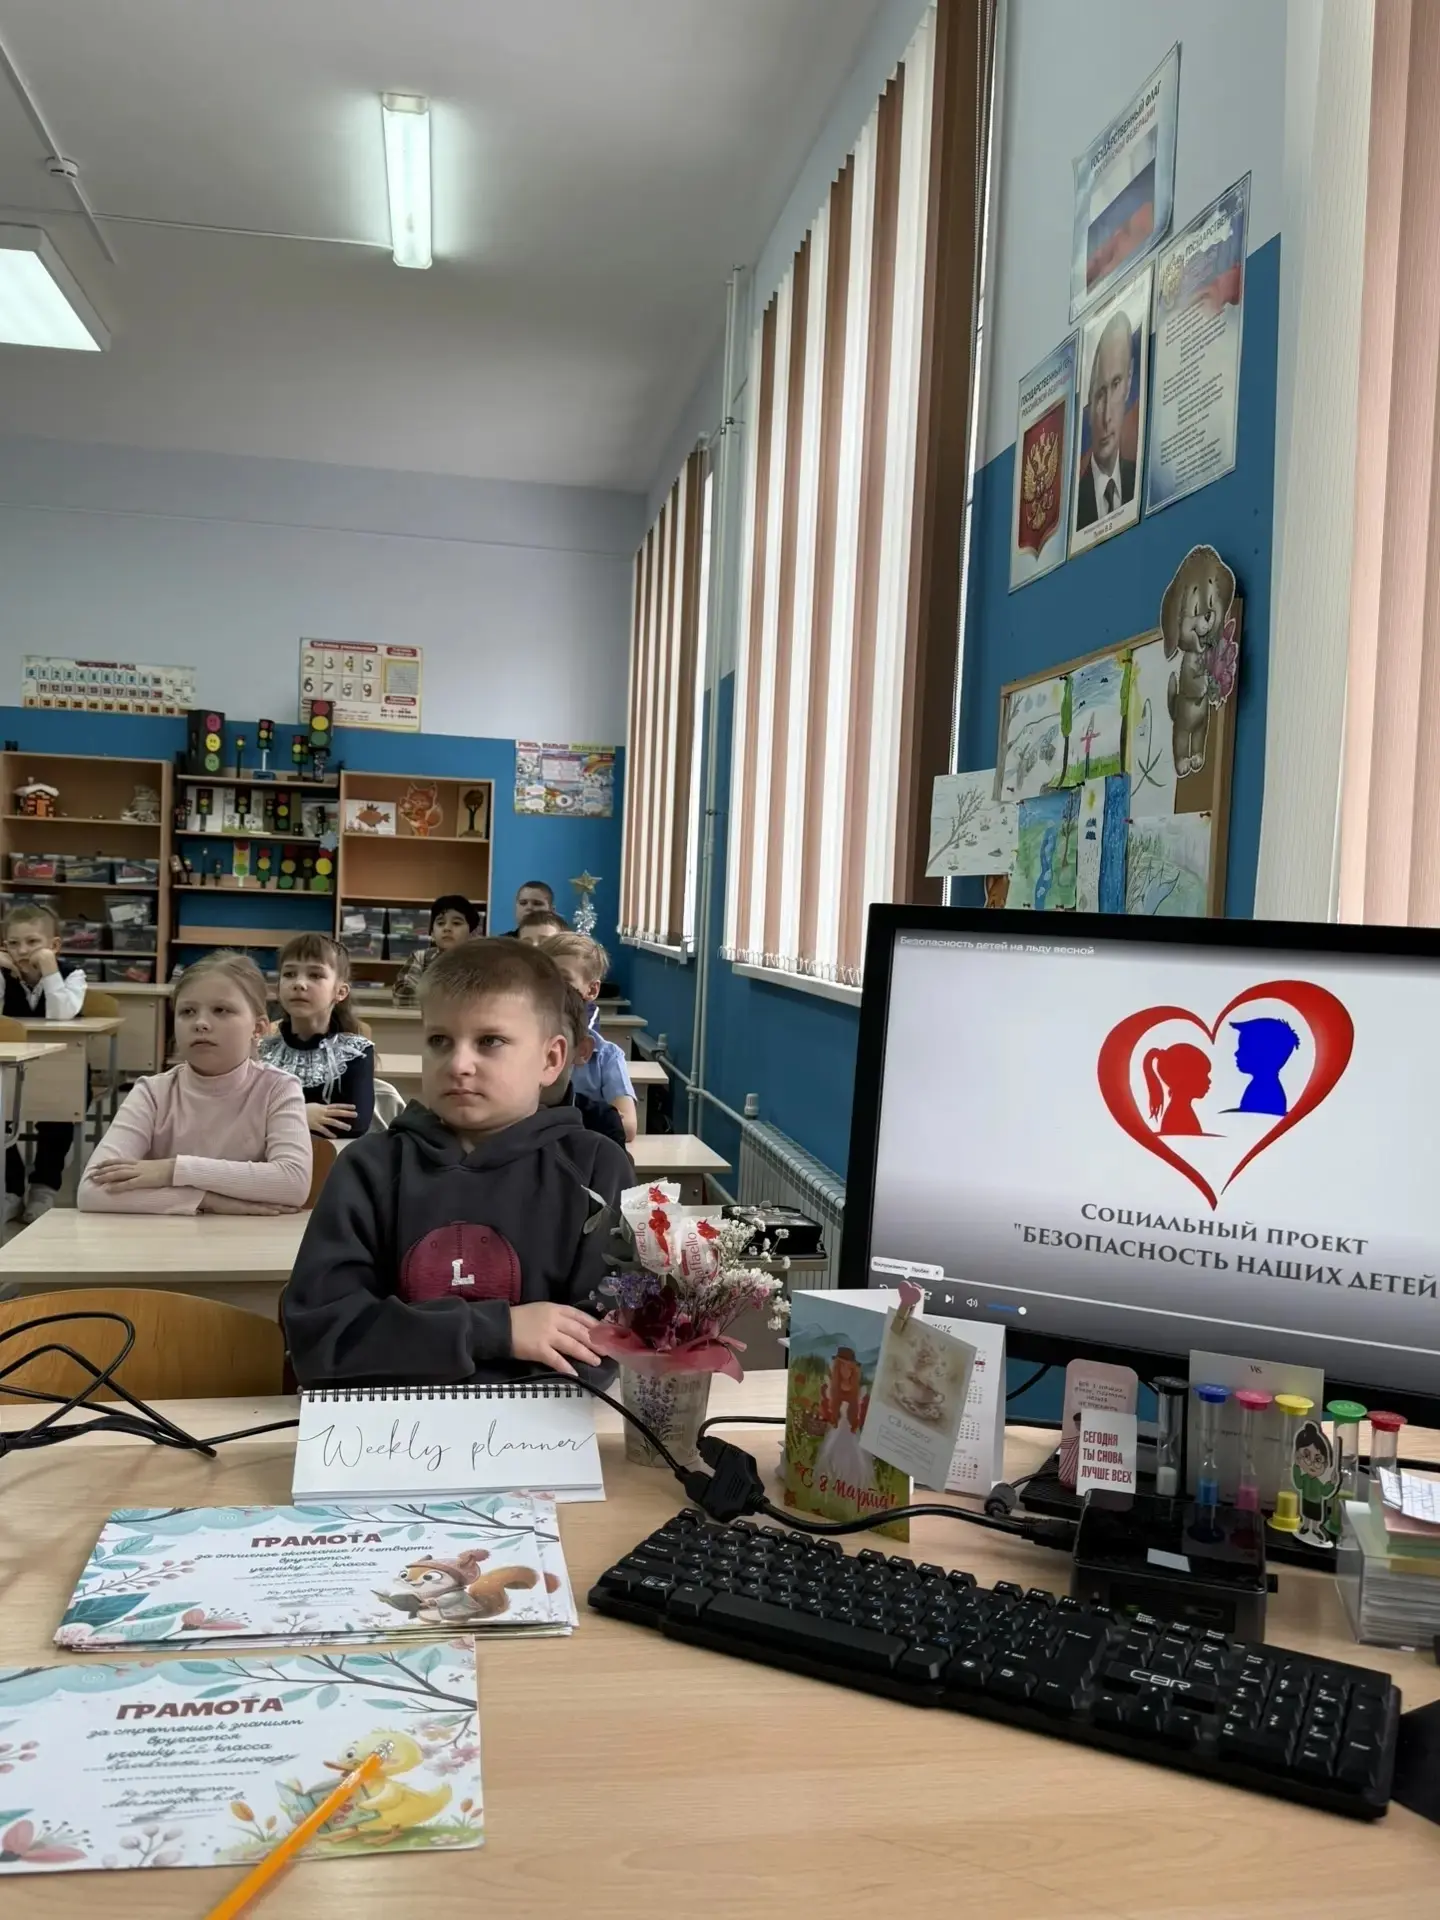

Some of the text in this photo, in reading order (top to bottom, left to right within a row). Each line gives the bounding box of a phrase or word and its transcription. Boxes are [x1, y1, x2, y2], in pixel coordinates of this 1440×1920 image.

[304, 655, 315, 668] 2
[324, 656, 334, 669] 3
[363, 659, 374, 673] 5
[303, 677, 372, 697] 6 7 8 9
[900, 936, 1095, 956] Безопасность детей на льду весной
[1266, 1228, 1369, 1256] ПРОЕКТ
[1013, 1222, 1438, 1299] "БЕЗОПАСНОСТЬ НАШИХ ДЕТЕЙ
[451, 1258, 475, 1286] L
[298, 1418, 596, 1472] Weekly planner
[1083, 1430, 1119, 1447] СЕГОДНЯ
[1082, 1448, 1124, 1465] ТЫ СНОВА
[801, 1467, 814, 1489] С
[818, 1474, 828, 1493] 8
[1080, 1465, 1132, 1484] ЛУЧШЕ ВСЕХ
[250, 1533, 383, 1548] ГРАМОТА
[194, 1553, 213, 1561] за
[215, 1550, 280, 1560] отличное
[281, 1547, 349, 1557] окончание
[368, 1544, 435, 1554] четверти
[278, 1555, 353, 1565] вручается
[249, 1564, 307, 1574] ученику
[332, 1560, 378, 1569] класса
[116, 1697, 284, 1720] ГРАМОТА
[86, 1719, 304, 1740] за стремление к знаниям
[147, 1733, 243, 1746] вручается
[105, 1748, 177, 1762] ученику
[213, 1742, 273, 1752] класса
